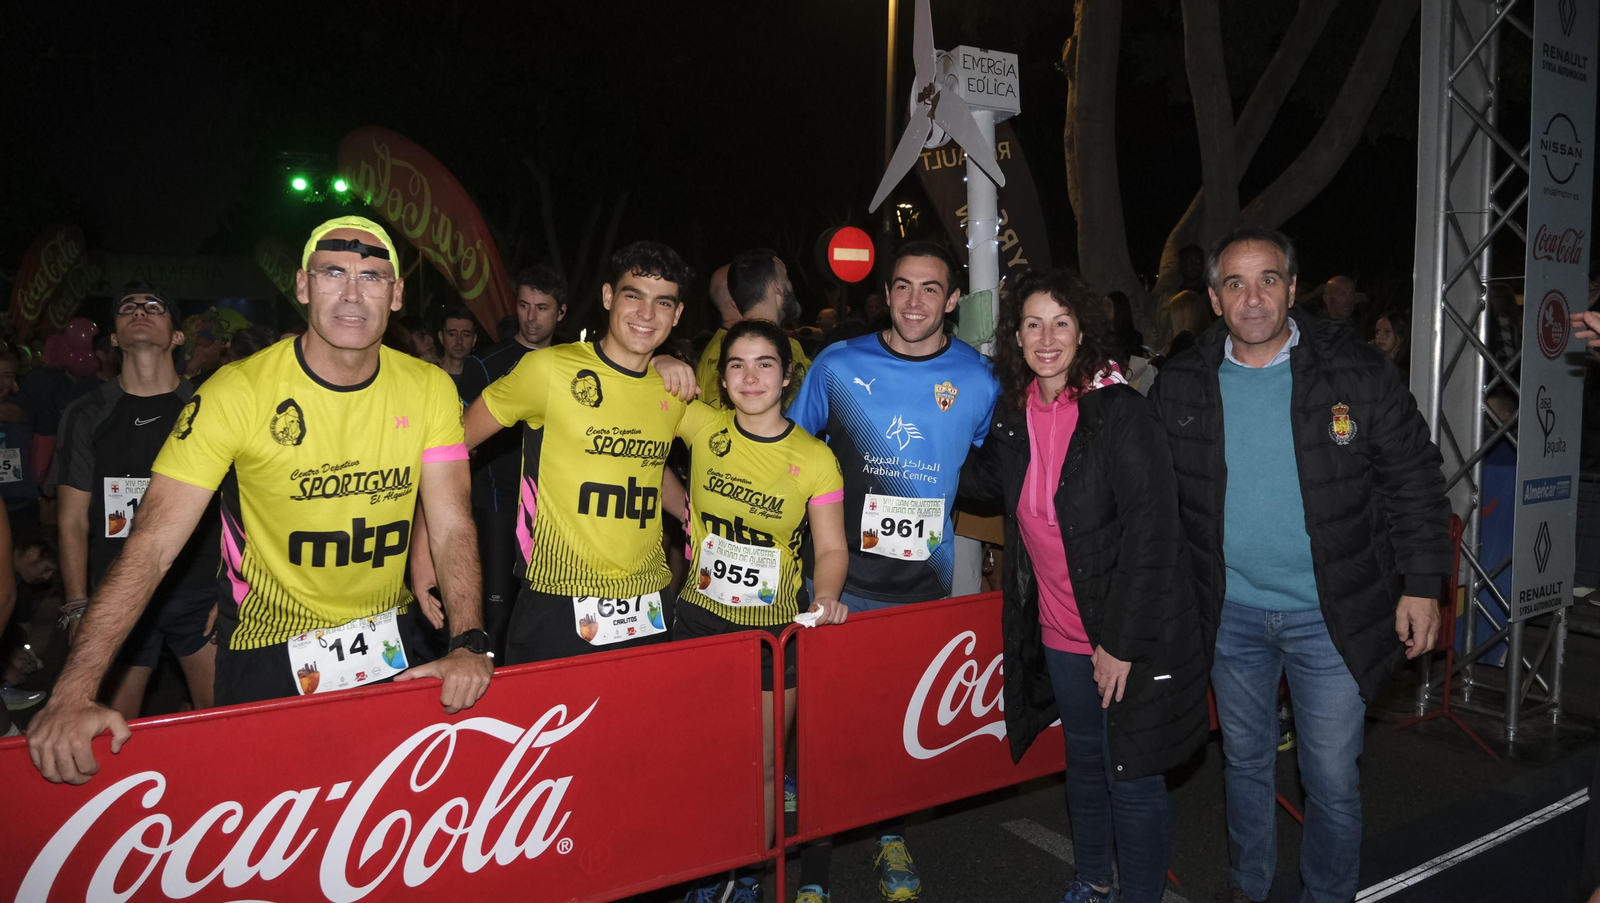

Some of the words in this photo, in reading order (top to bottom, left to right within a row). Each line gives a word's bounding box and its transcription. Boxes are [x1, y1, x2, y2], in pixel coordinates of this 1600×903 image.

[1542, 43, 1588, 70] RENAULT
[1540, 138, 1582, 159] NISSAN
[1533, 223, 1586, 265] Coca-Cola
[585, 426, 610, 436] Centro
[612, 427, 642, 437] Deportivo
[585, 435, 670, 460] SPORTGYM
[863, 452, 900, 466] العربية
[902, 459, 940, 472] المراكز
[290, 469, 320, 481] Centro
[321, 460, 361, 474] Deportivo
[706, 468, 724, 478] Centro
[724, 473, 753, 485] Deportivo
[862, 464, 900, 478] Arabian
[902, 469, 938, 484] Centres
[290, 466, 413, 501] SPORTGYM
[1523, 482, 1557, 501] Almericar
[369, 494, 381, 505] El
[577, 476, 659, 529] mtp
[703, 475, 786, 515] SPORTGYM
[748, 506, 758, 514] El
[880, 517, 925, 538] 961
[289, 517, 410, 569] mtp
[712, 559, 760, 588] 955
[1519, 581, 1563, 603] RENAULT
[597, 595, 642, 618] 657
[613, 616, 637, 626] CARLITOS
[328, 632, 369, 662] 14
[14, 696, 600, 903] Coca-Cola
